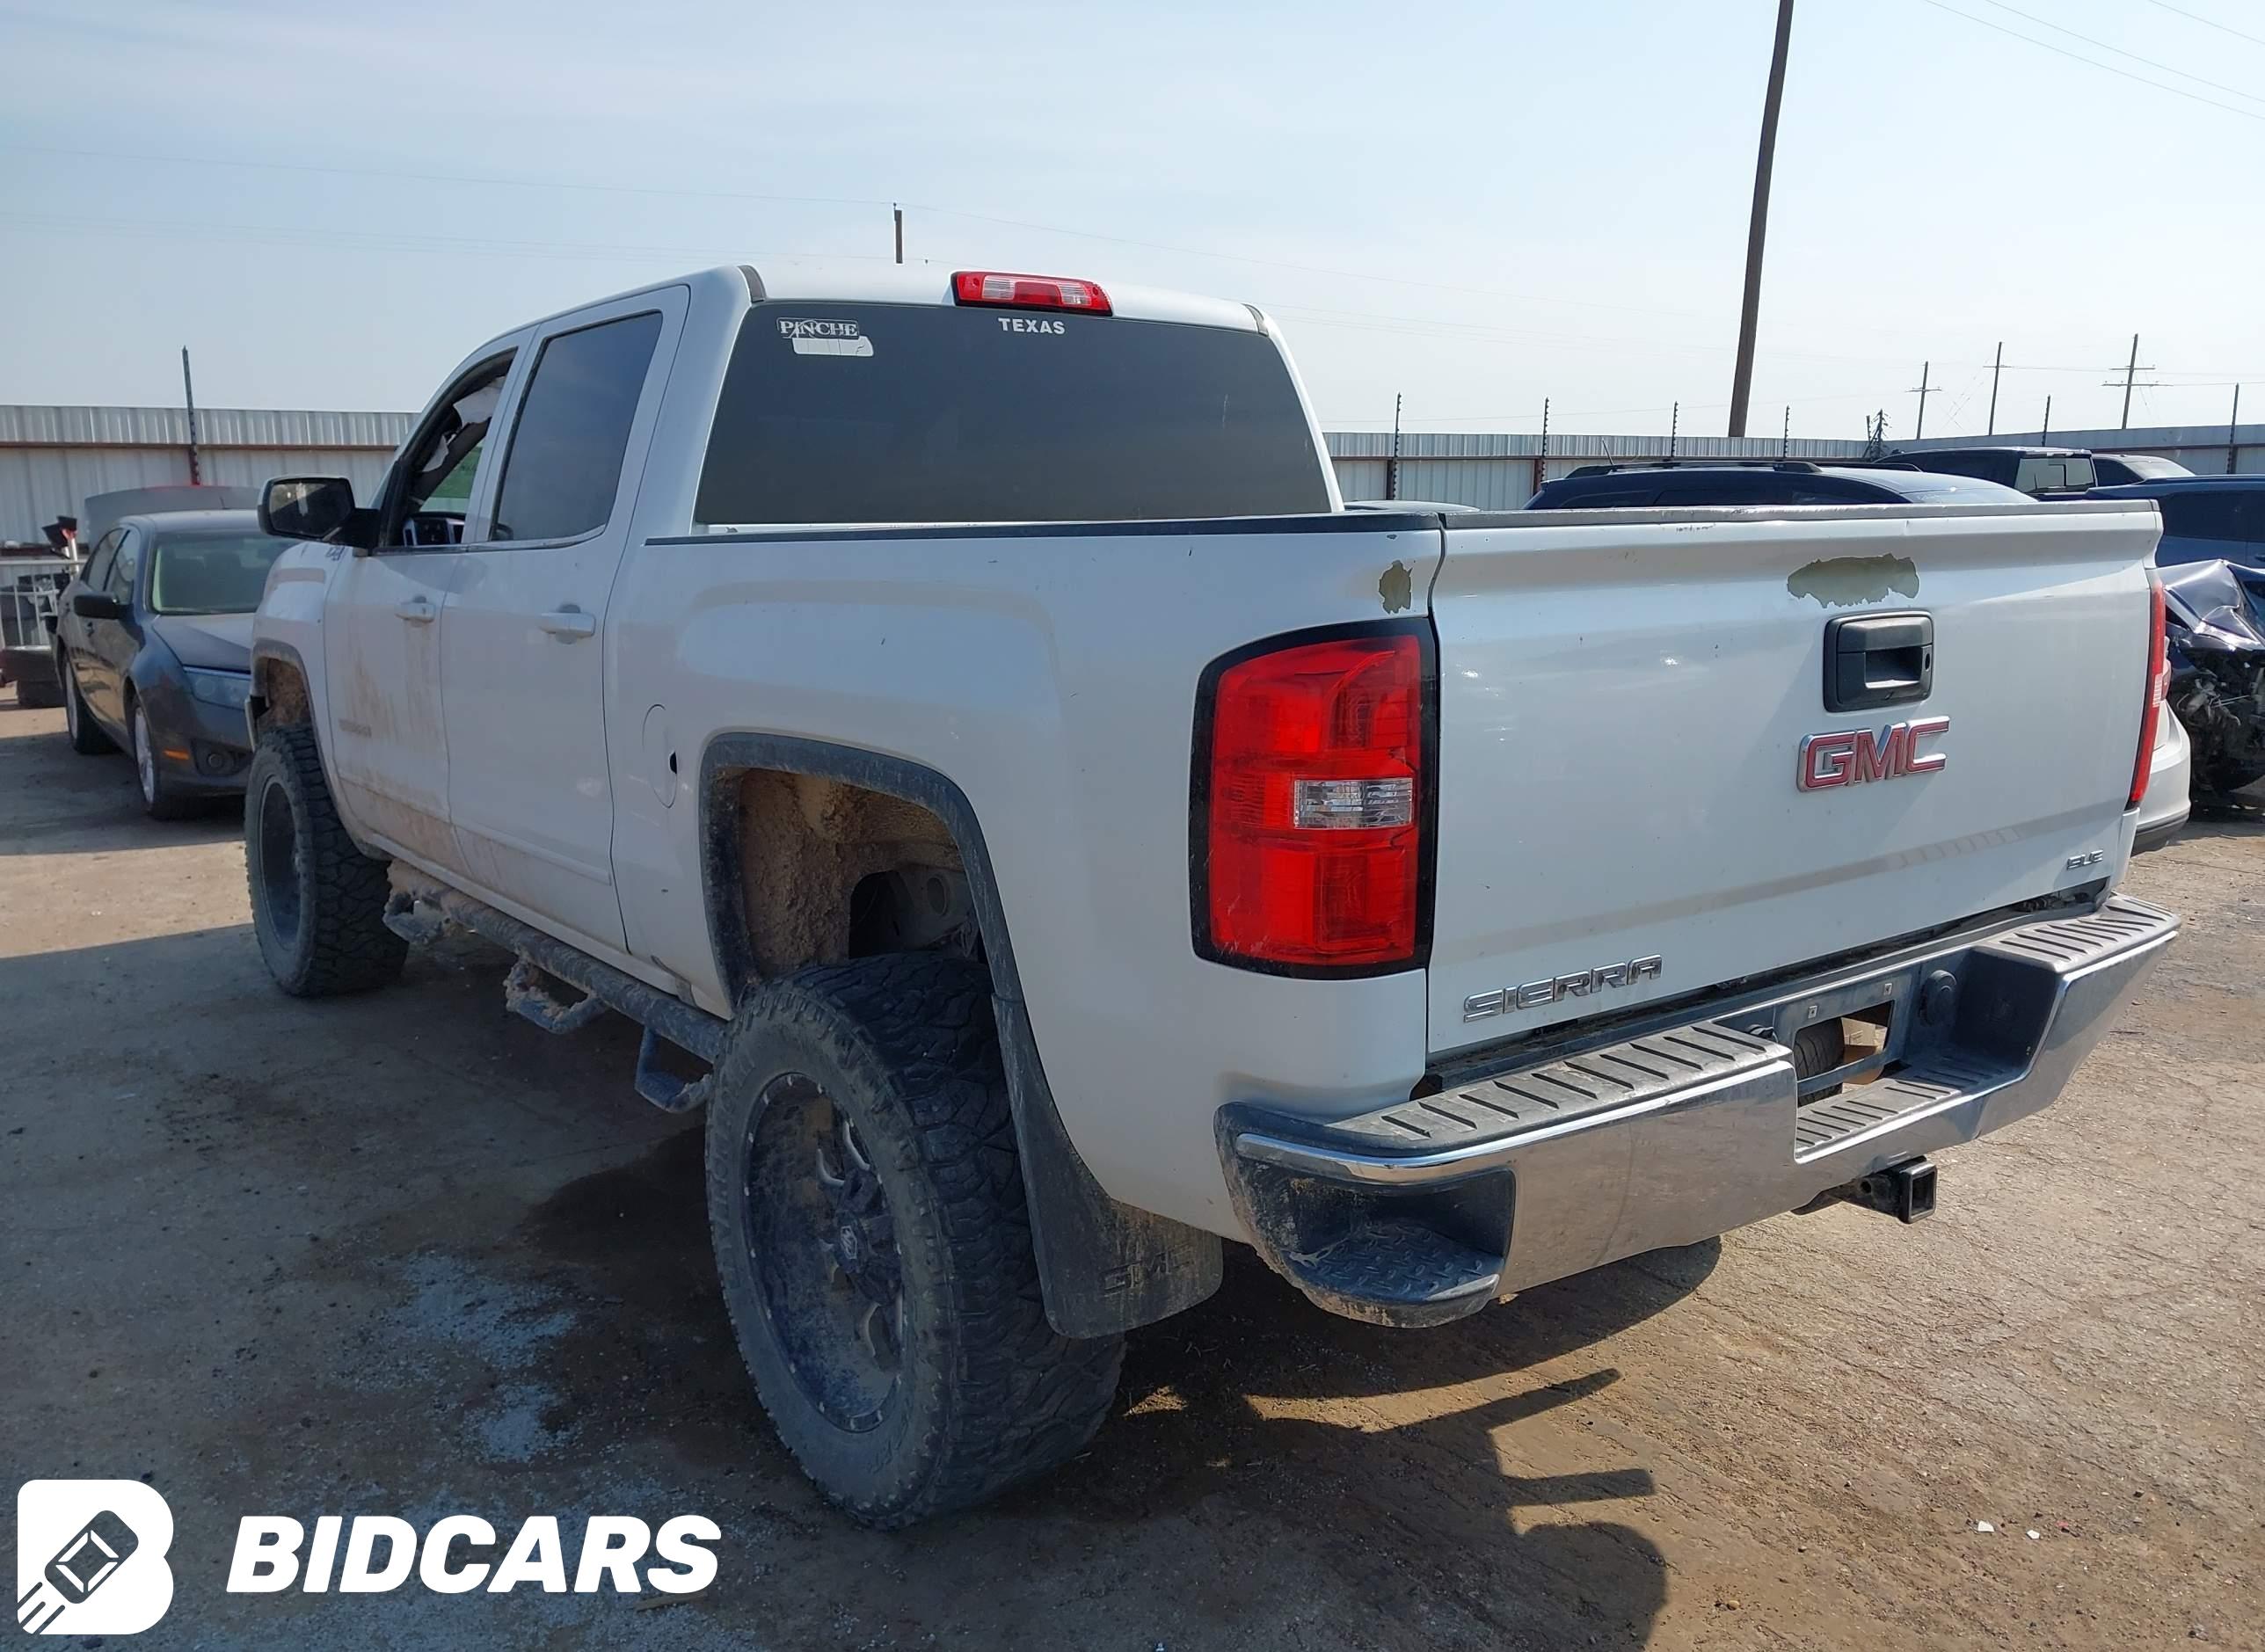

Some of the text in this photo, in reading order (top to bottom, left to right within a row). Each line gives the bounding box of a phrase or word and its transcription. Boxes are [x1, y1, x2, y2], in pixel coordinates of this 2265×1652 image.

[779, 321, 859, 338] PINCHE
[998, 317, 1066, 334] TEXAS
[1796, 716, 1950, 792] GMC
[2066, 849, 2104, 870] SLE
[1463, 954, 1663, 1023] SIERRA
